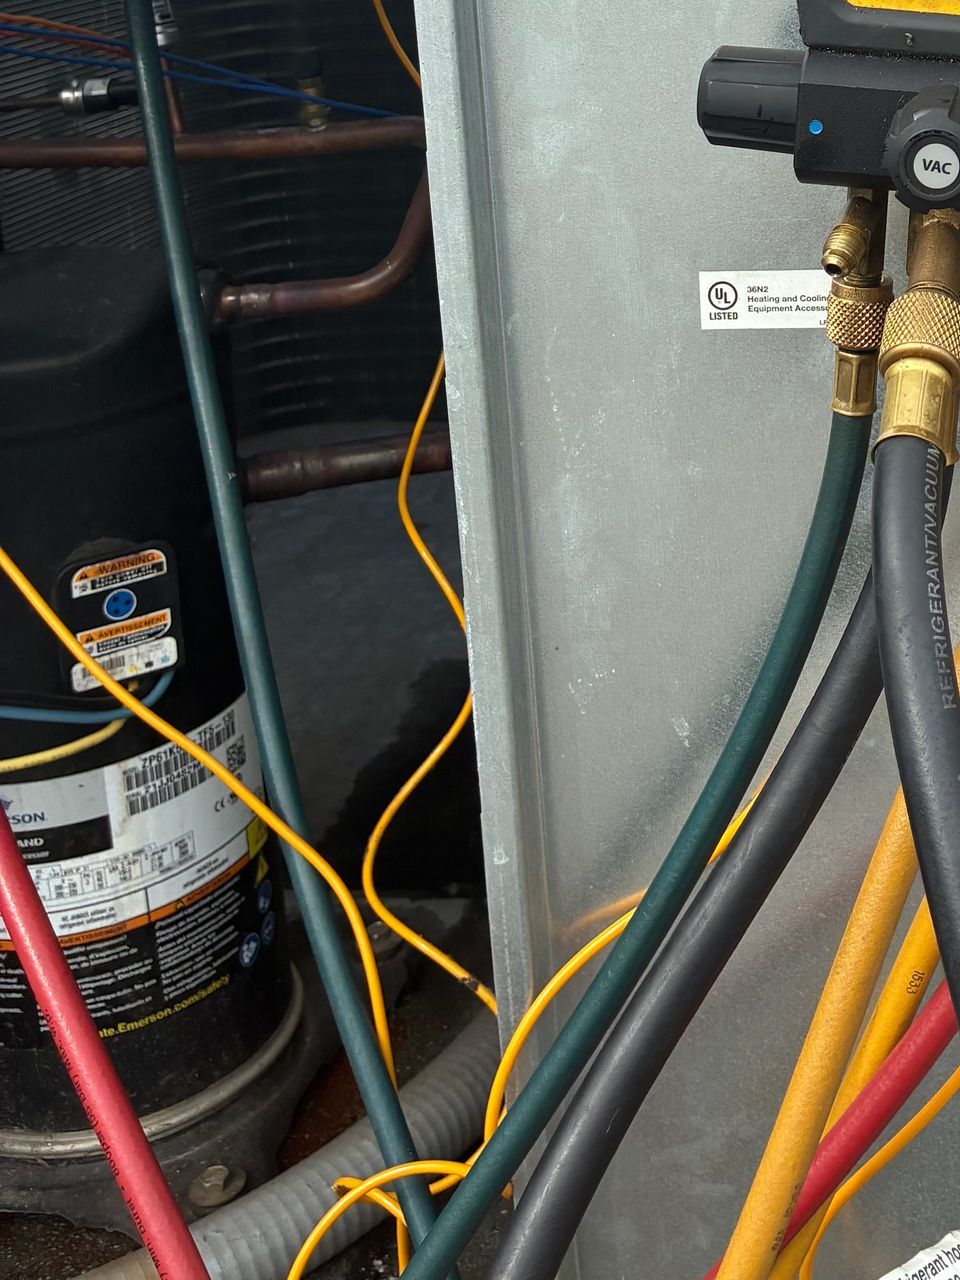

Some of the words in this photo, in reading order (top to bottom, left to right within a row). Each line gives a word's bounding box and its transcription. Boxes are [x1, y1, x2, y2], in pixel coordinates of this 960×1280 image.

[922, 158, 952, 174] VAC
[715, 288, 731, 304] UL
[747, 295, 780, 304] Heating
[782, 294, 798, 302] and
[748, 304, 793, 314] Equipment
[709, 312, 738, 320] LISTED
[100, 553, 155, 572] WARNING
